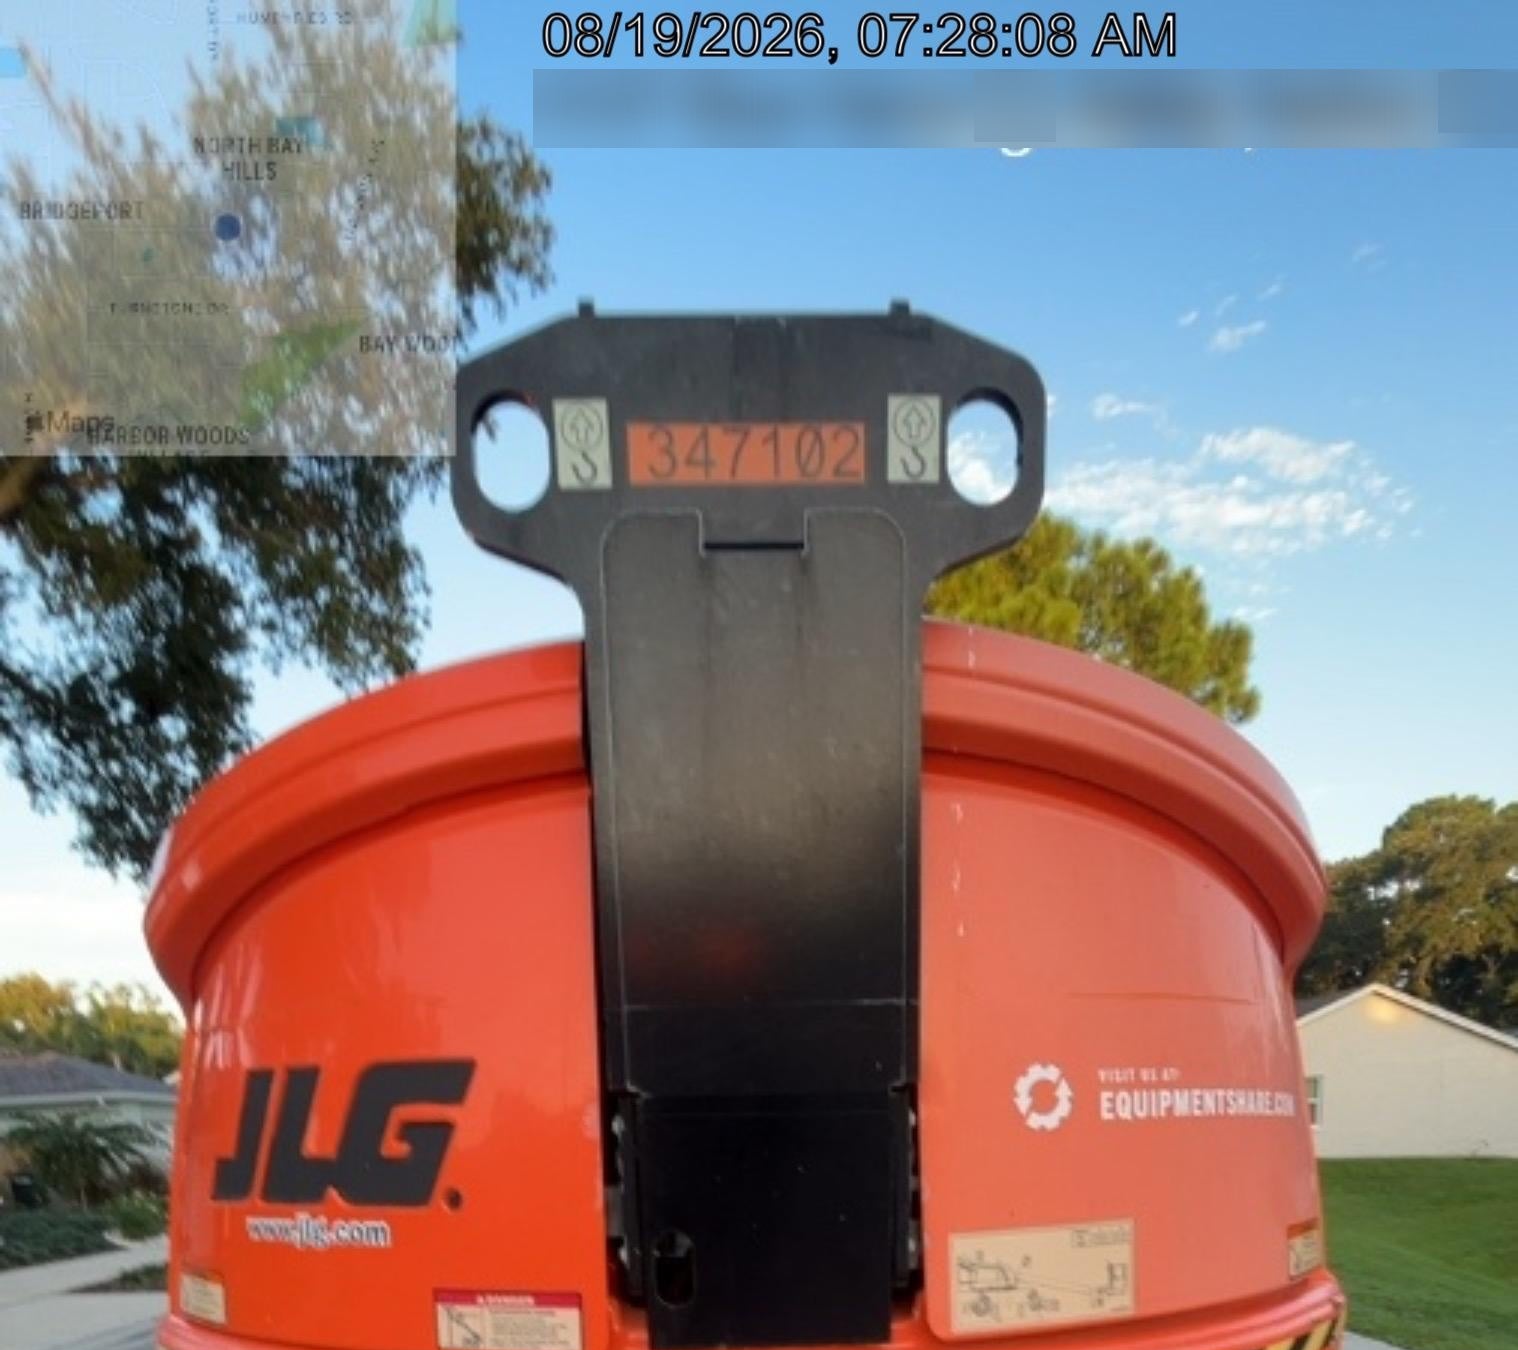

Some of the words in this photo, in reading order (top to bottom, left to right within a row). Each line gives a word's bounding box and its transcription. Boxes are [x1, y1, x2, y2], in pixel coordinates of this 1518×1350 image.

[647, 423, 861, 479] 347102
[1101, 1088, 1295, 1120] EQUIPMENTSHARE.COM
[212, 1060, 476, 1207] JLG
